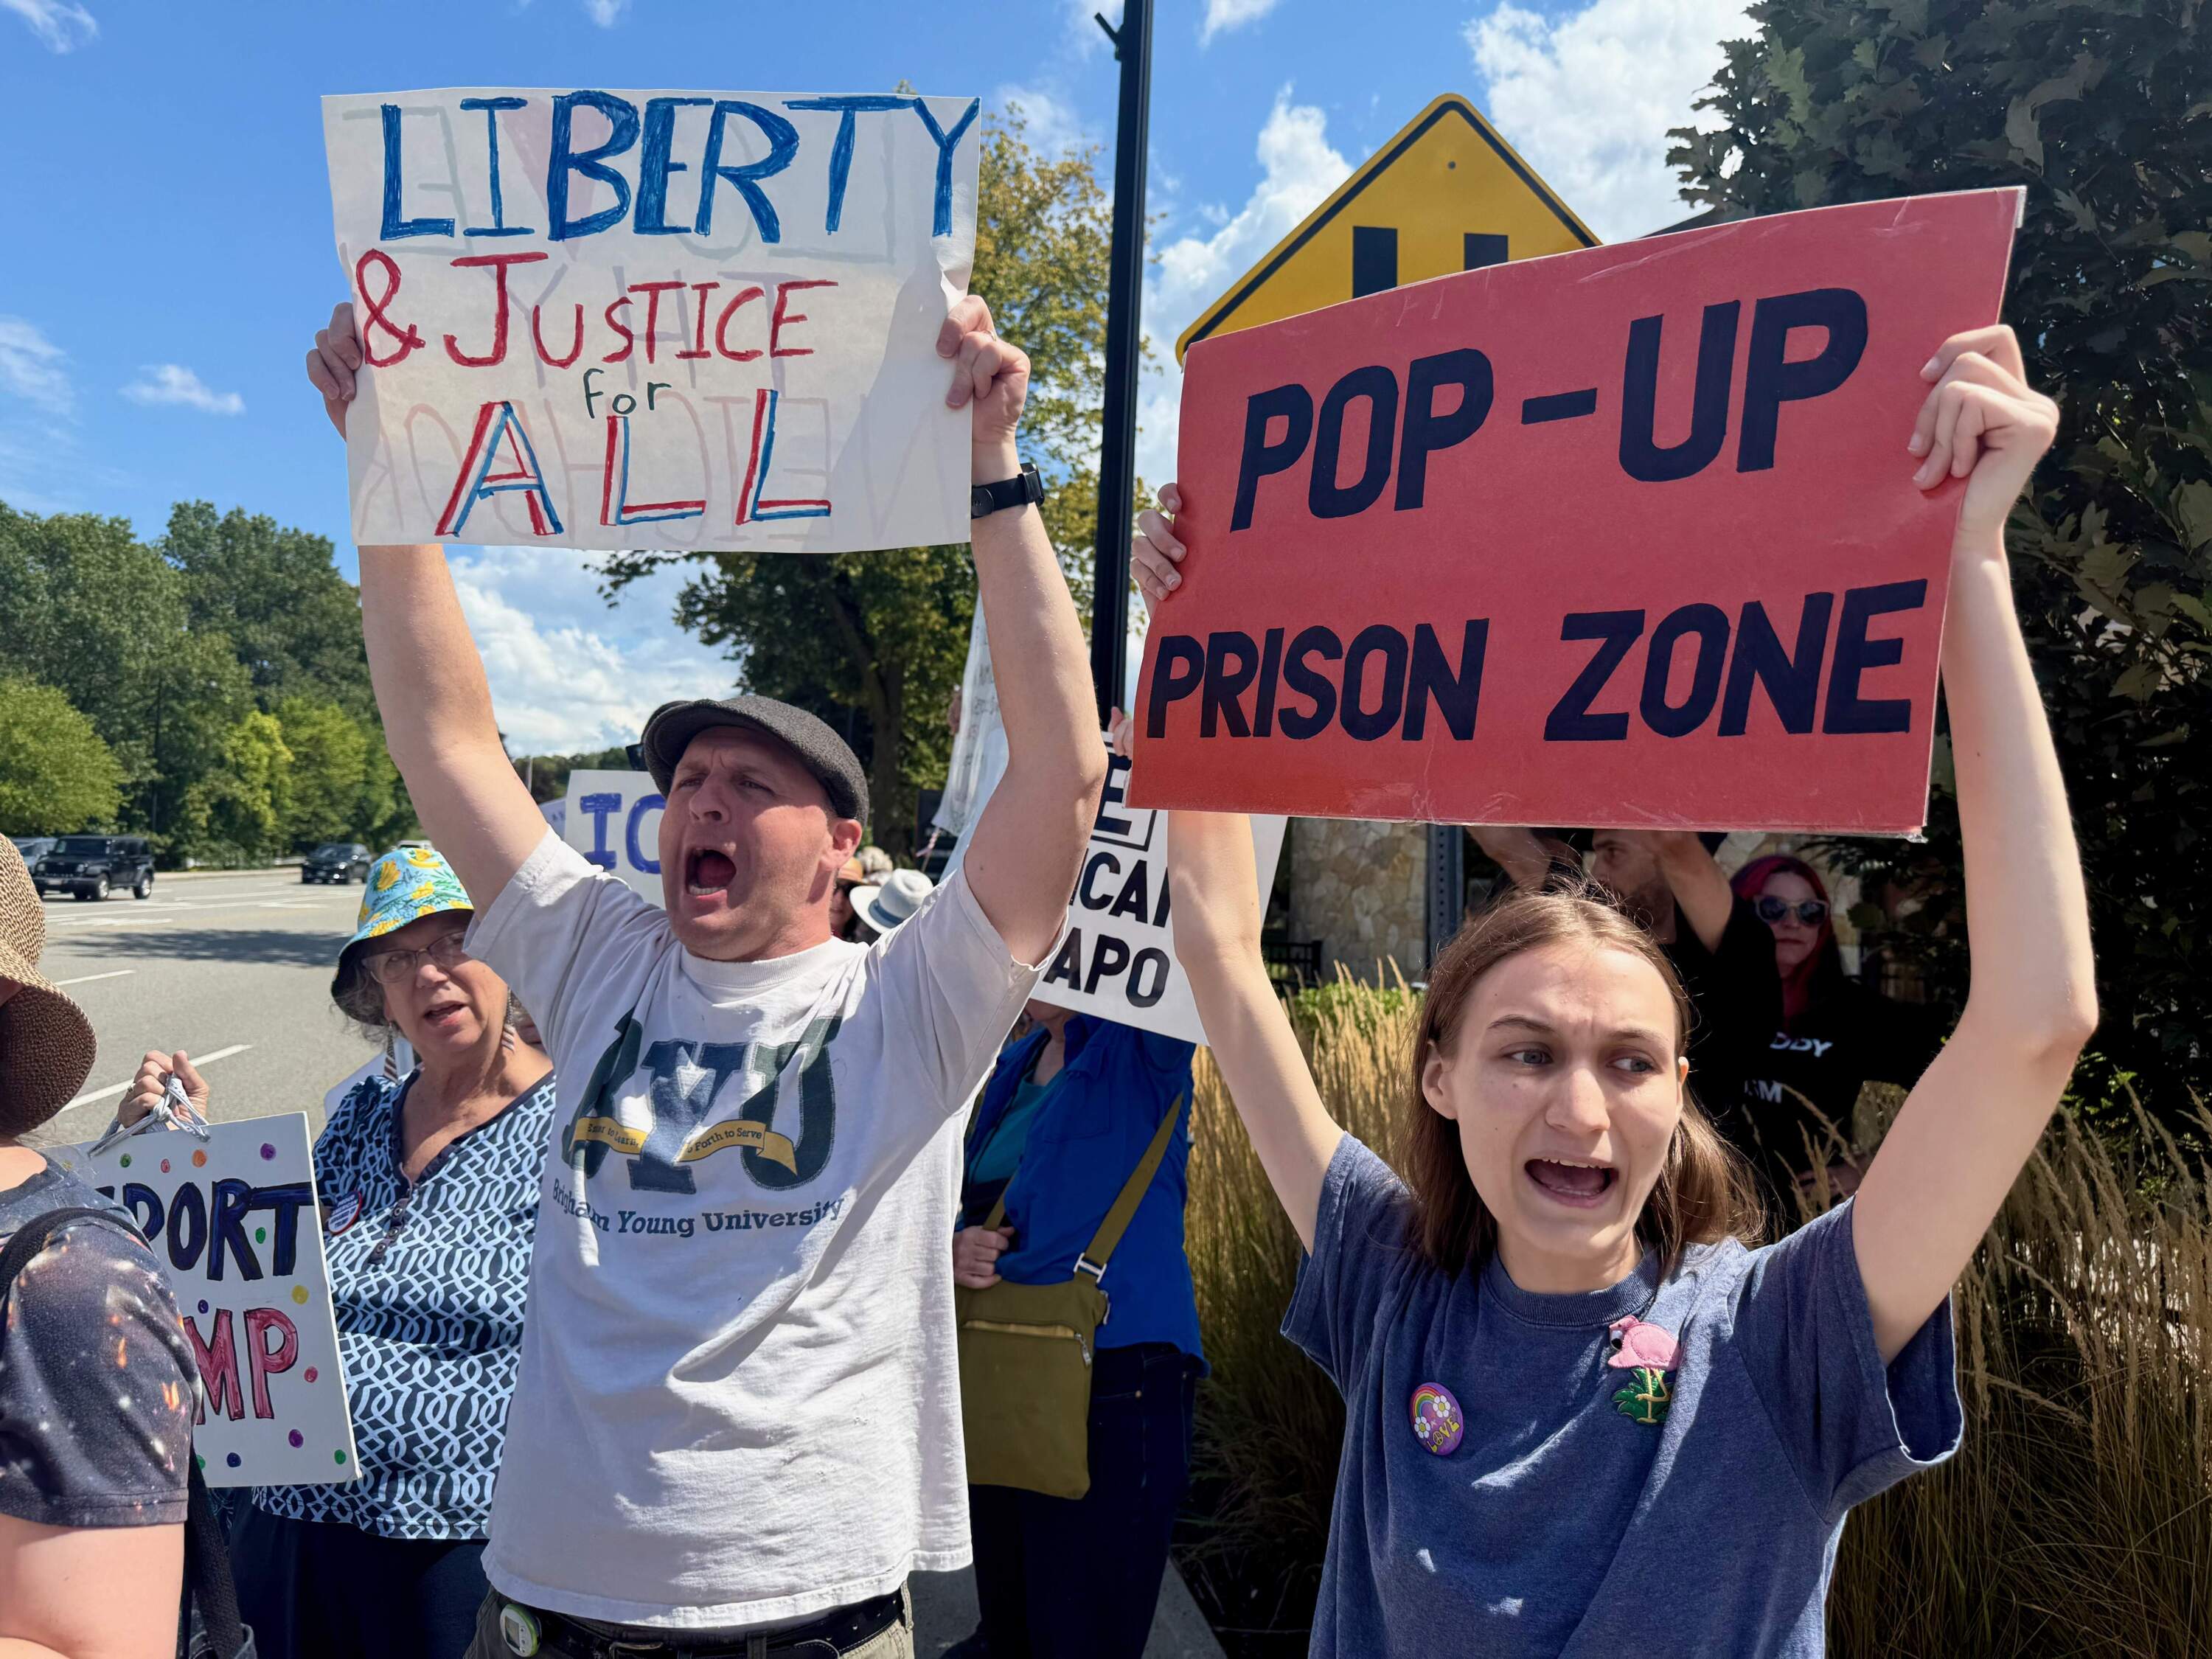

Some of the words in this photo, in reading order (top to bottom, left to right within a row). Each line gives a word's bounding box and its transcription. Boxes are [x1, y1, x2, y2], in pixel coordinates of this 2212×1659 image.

[380, 90, 981, 243] LIBERTY
[355, 248, 425, 368] &
[434, 388, 832, 537] ALL
[1229, 288, 1869, 533] POP-UP
[1146, 617, 1490, 742] PRISON
[1543, 579, 1928, 742] ZONE
[724, 1130, 735, 1139] to
[737, 1127, 763, 1139] Serve
[617, 1210, 695, 1239] Young
[701, 1197, 845, 1232] University
